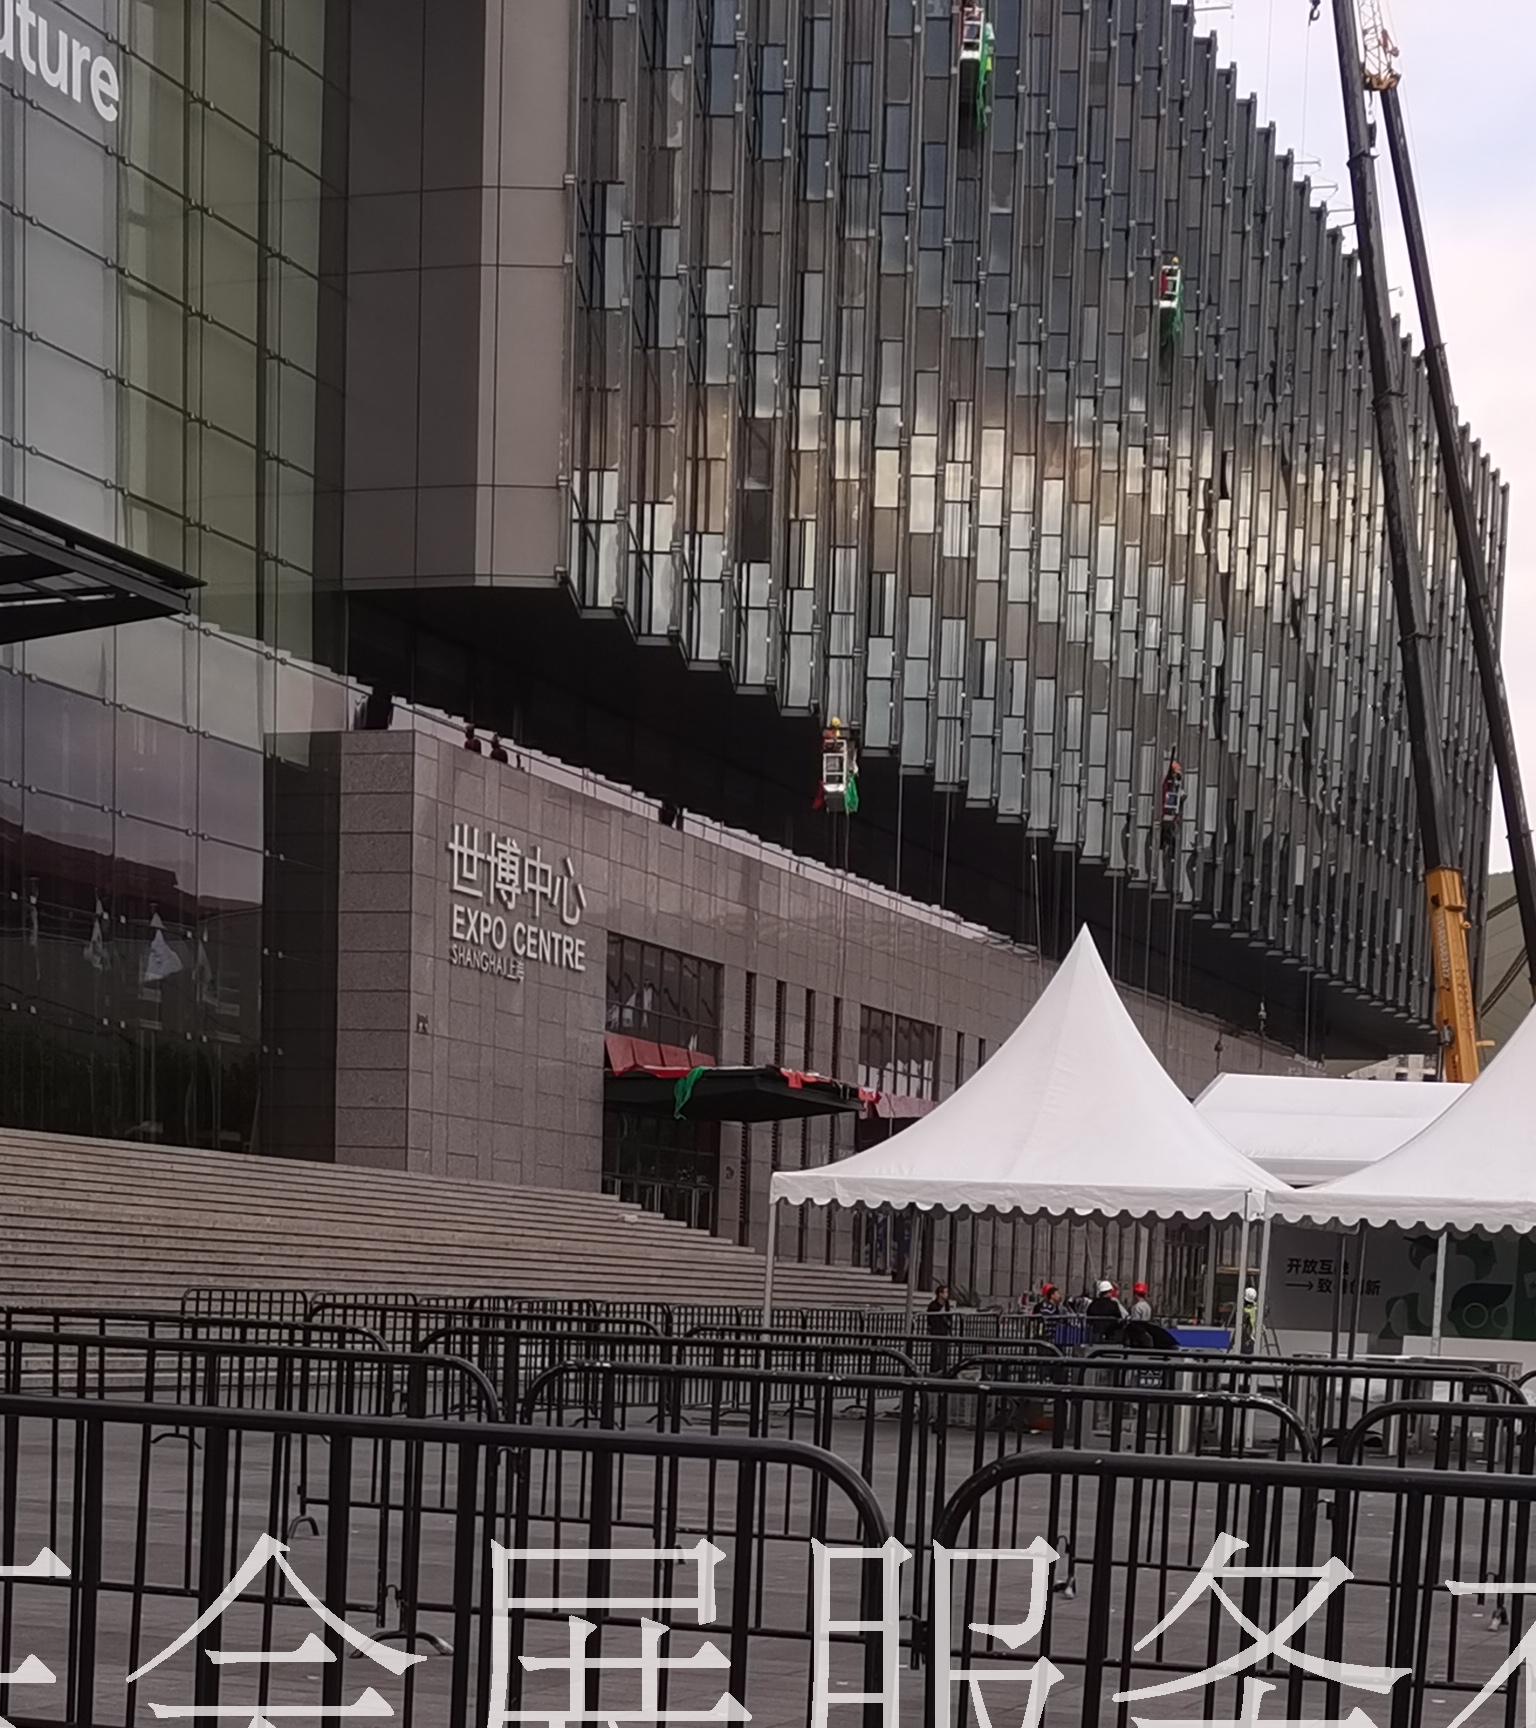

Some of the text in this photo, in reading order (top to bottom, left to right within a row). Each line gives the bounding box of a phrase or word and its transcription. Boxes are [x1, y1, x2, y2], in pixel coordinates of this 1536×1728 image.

[448, 824, 587, 925] 世博中心
[451, 943, 506, 975] SHANGHAI
[453, 904, 586, 971] EXPO CENTRE
